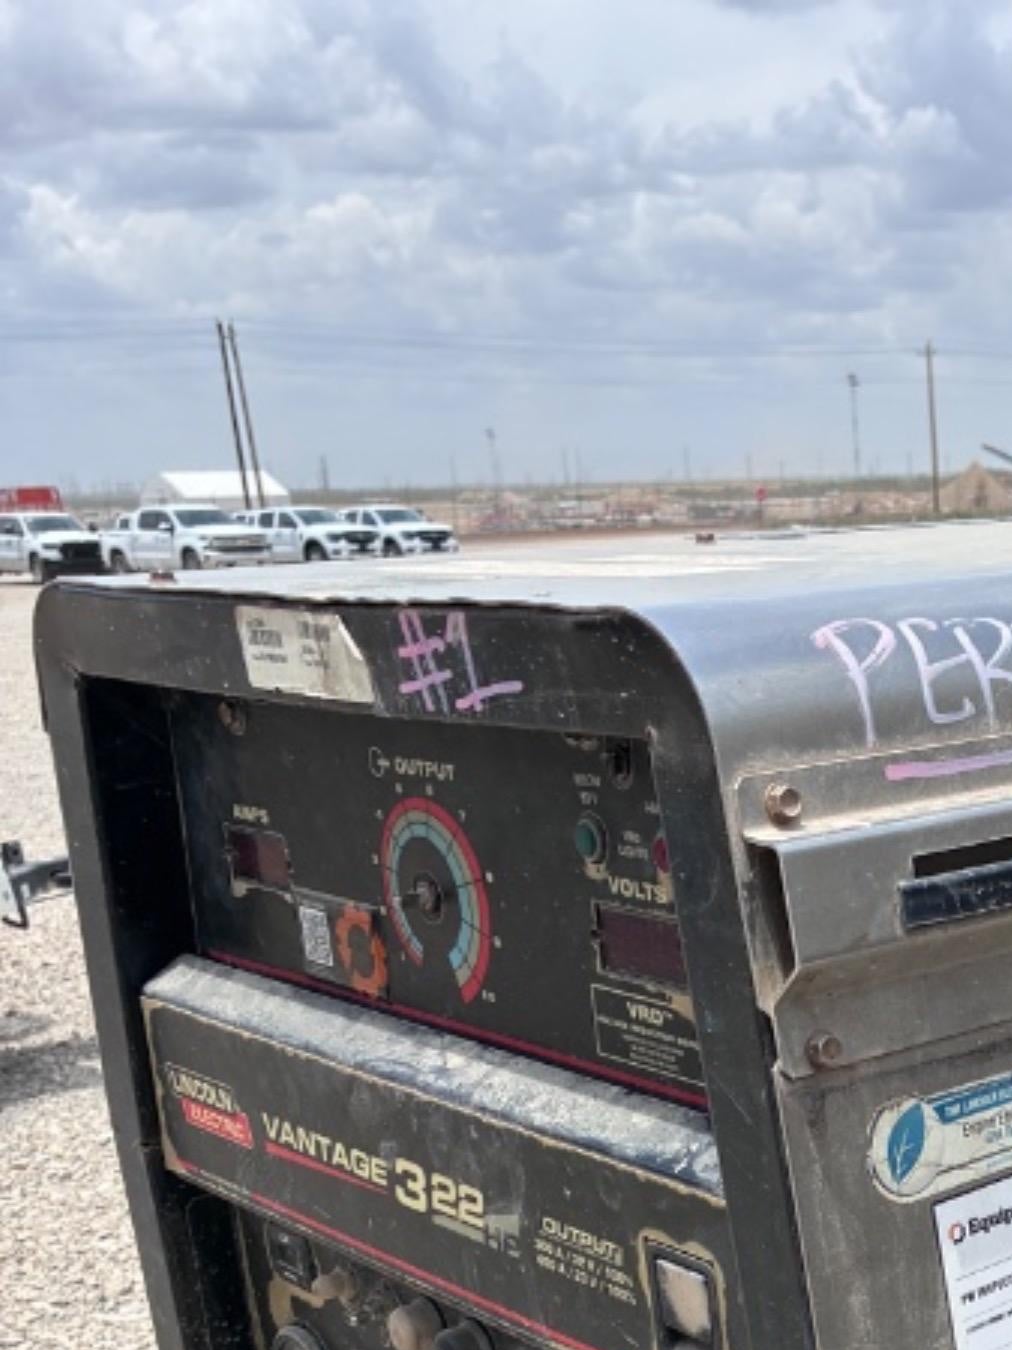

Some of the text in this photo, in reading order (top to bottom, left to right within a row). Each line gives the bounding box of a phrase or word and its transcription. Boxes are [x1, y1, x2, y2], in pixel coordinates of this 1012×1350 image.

[398, 607, 524, 714] #1
[394, 757, 455, 781] OUTPUT
[608, 875, 667, 904] VOLTS
[261, 1110, 484, 1230] VANTAGE 322
